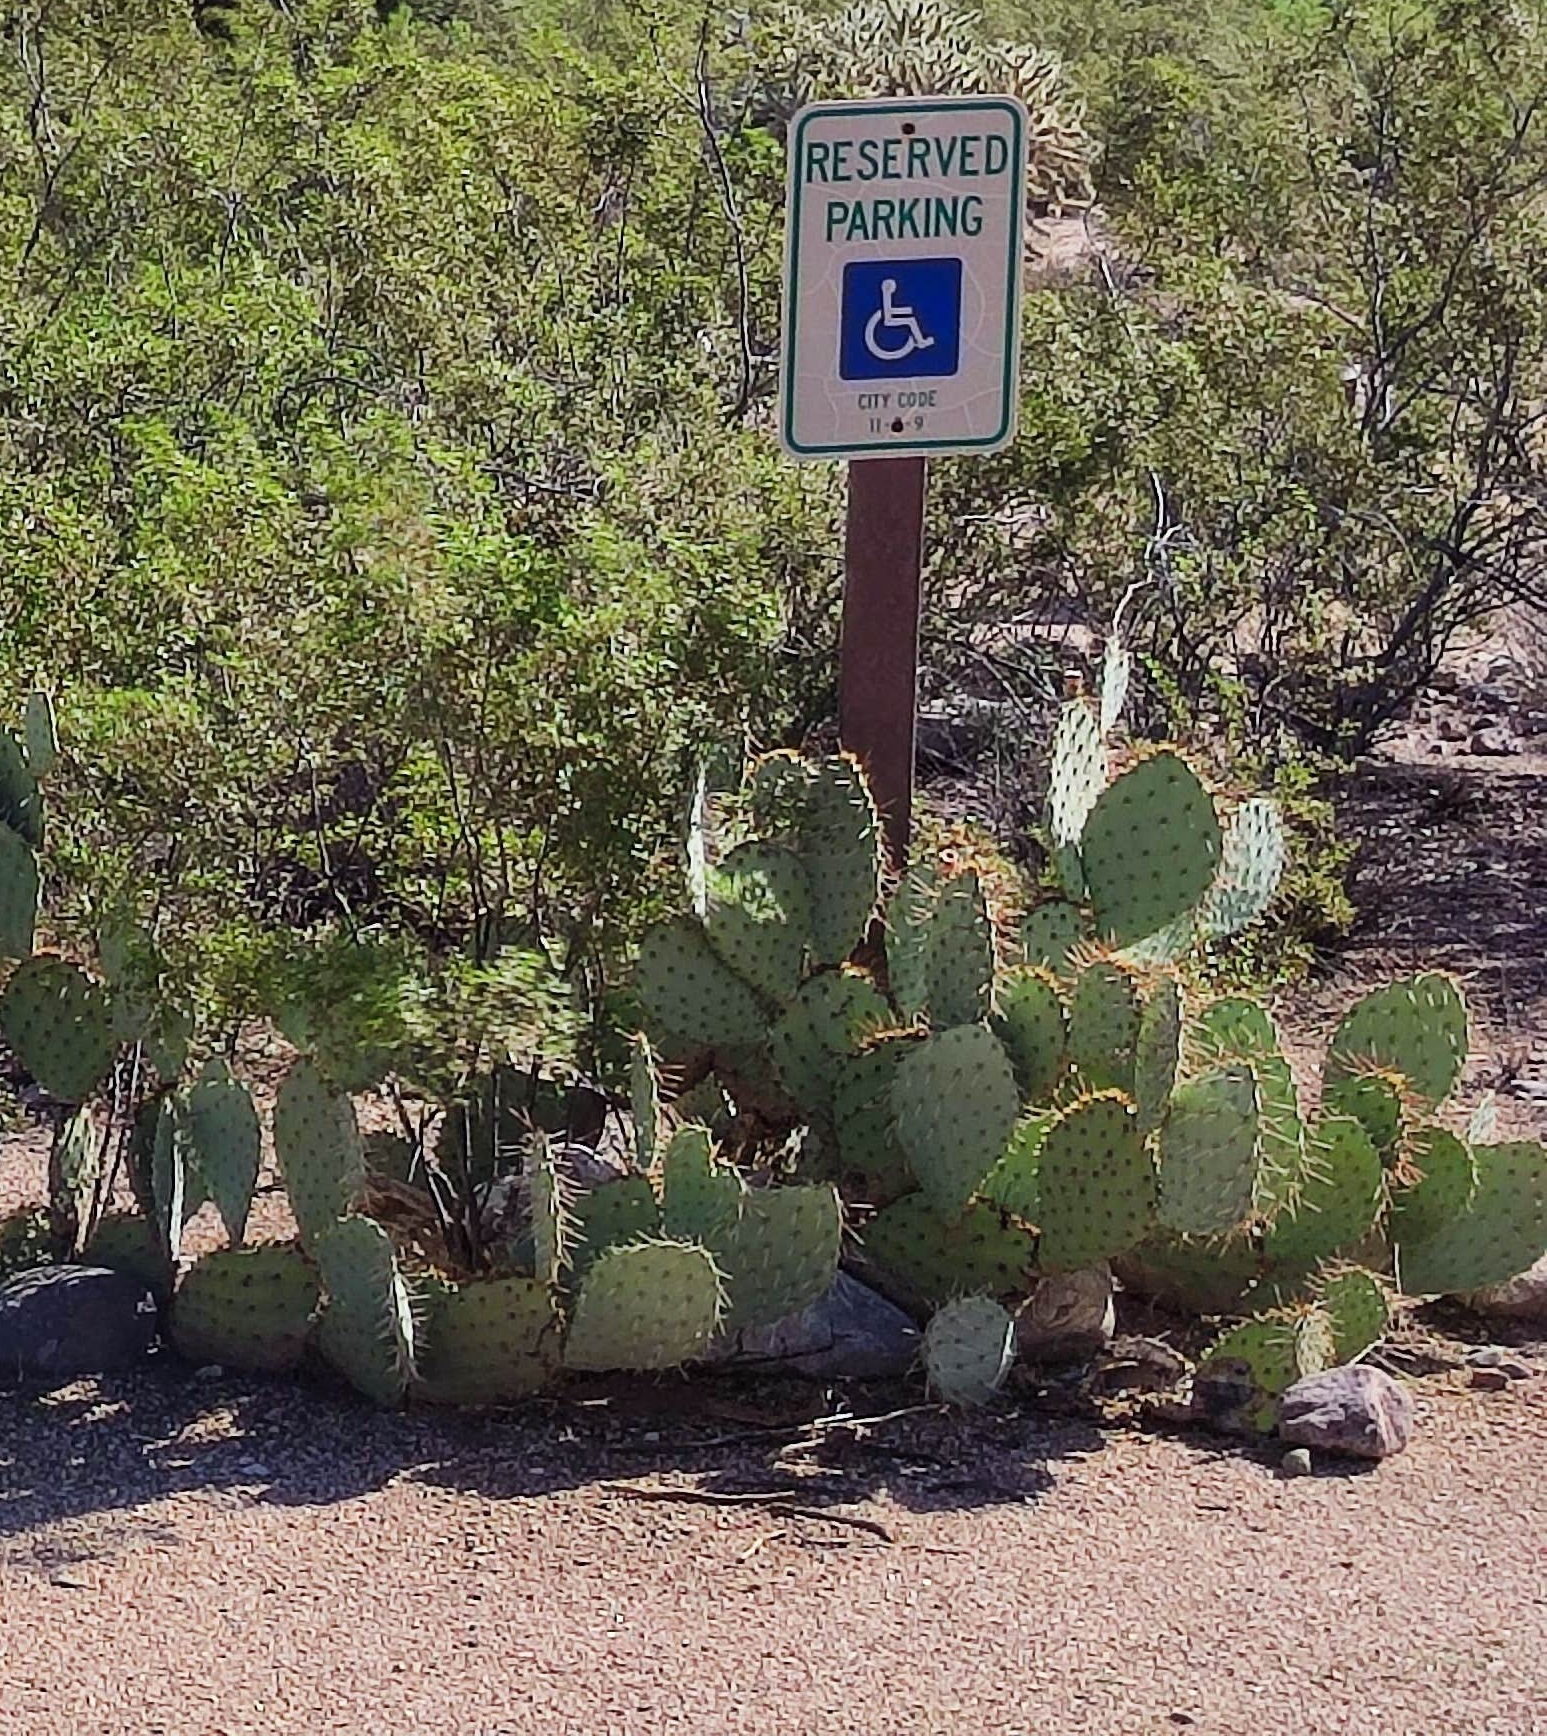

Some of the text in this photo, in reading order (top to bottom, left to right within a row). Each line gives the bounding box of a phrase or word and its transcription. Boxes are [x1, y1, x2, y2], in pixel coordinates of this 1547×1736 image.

[806, 135, 1008, 183] RESERVED
[826, 195, 984, 242] PARKING
[858, 389, 937, 410] CITY CODE
